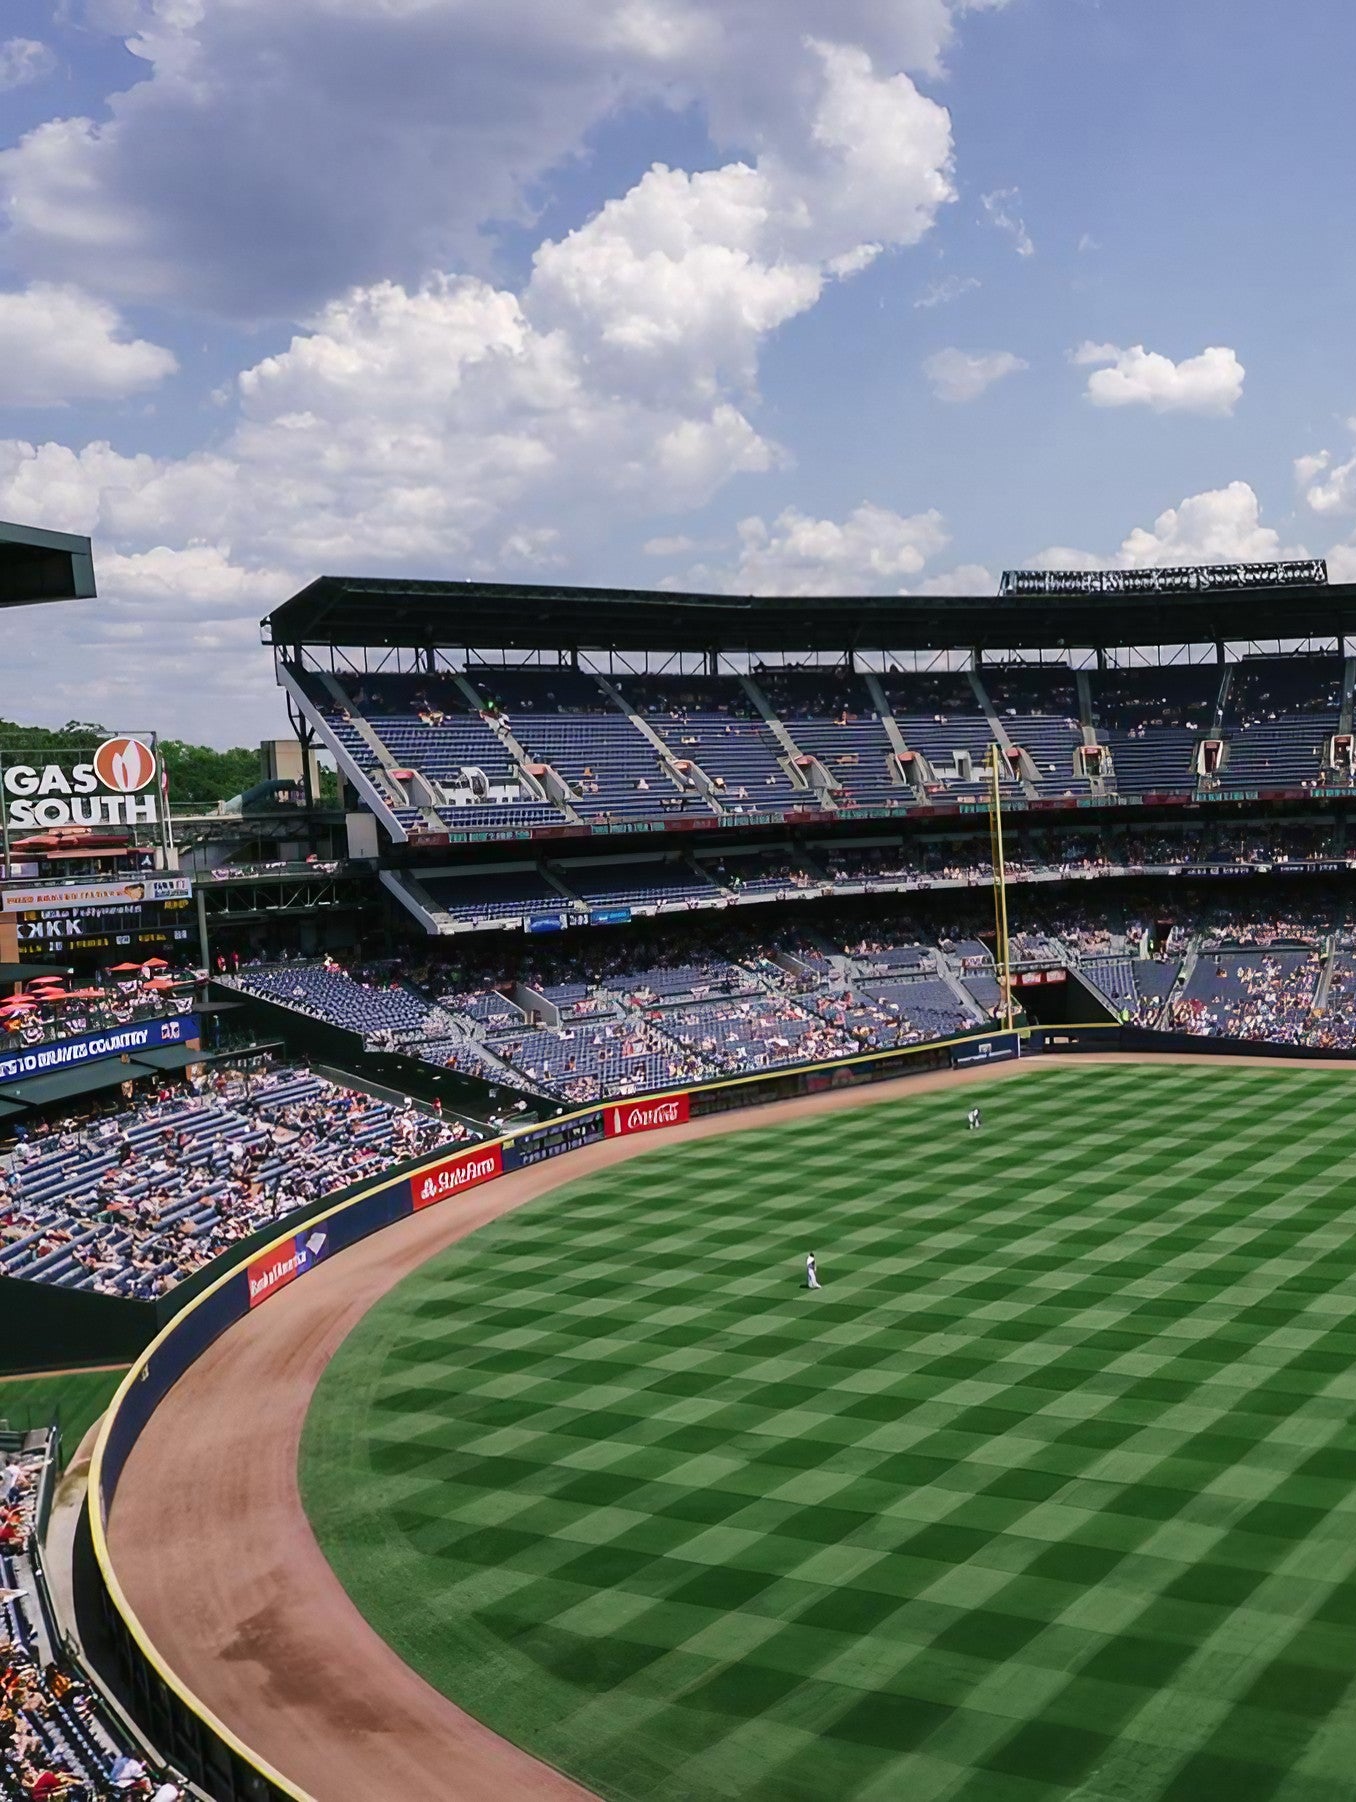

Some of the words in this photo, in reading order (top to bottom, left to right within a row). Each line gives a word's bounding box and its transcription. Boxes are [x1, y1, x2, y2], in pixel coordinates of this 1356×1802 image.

[4, 764, 98, 796] GAS
[8, 795, 157, 828] SOUTH
[89, 1029, 148, 1055] COUNTRY
